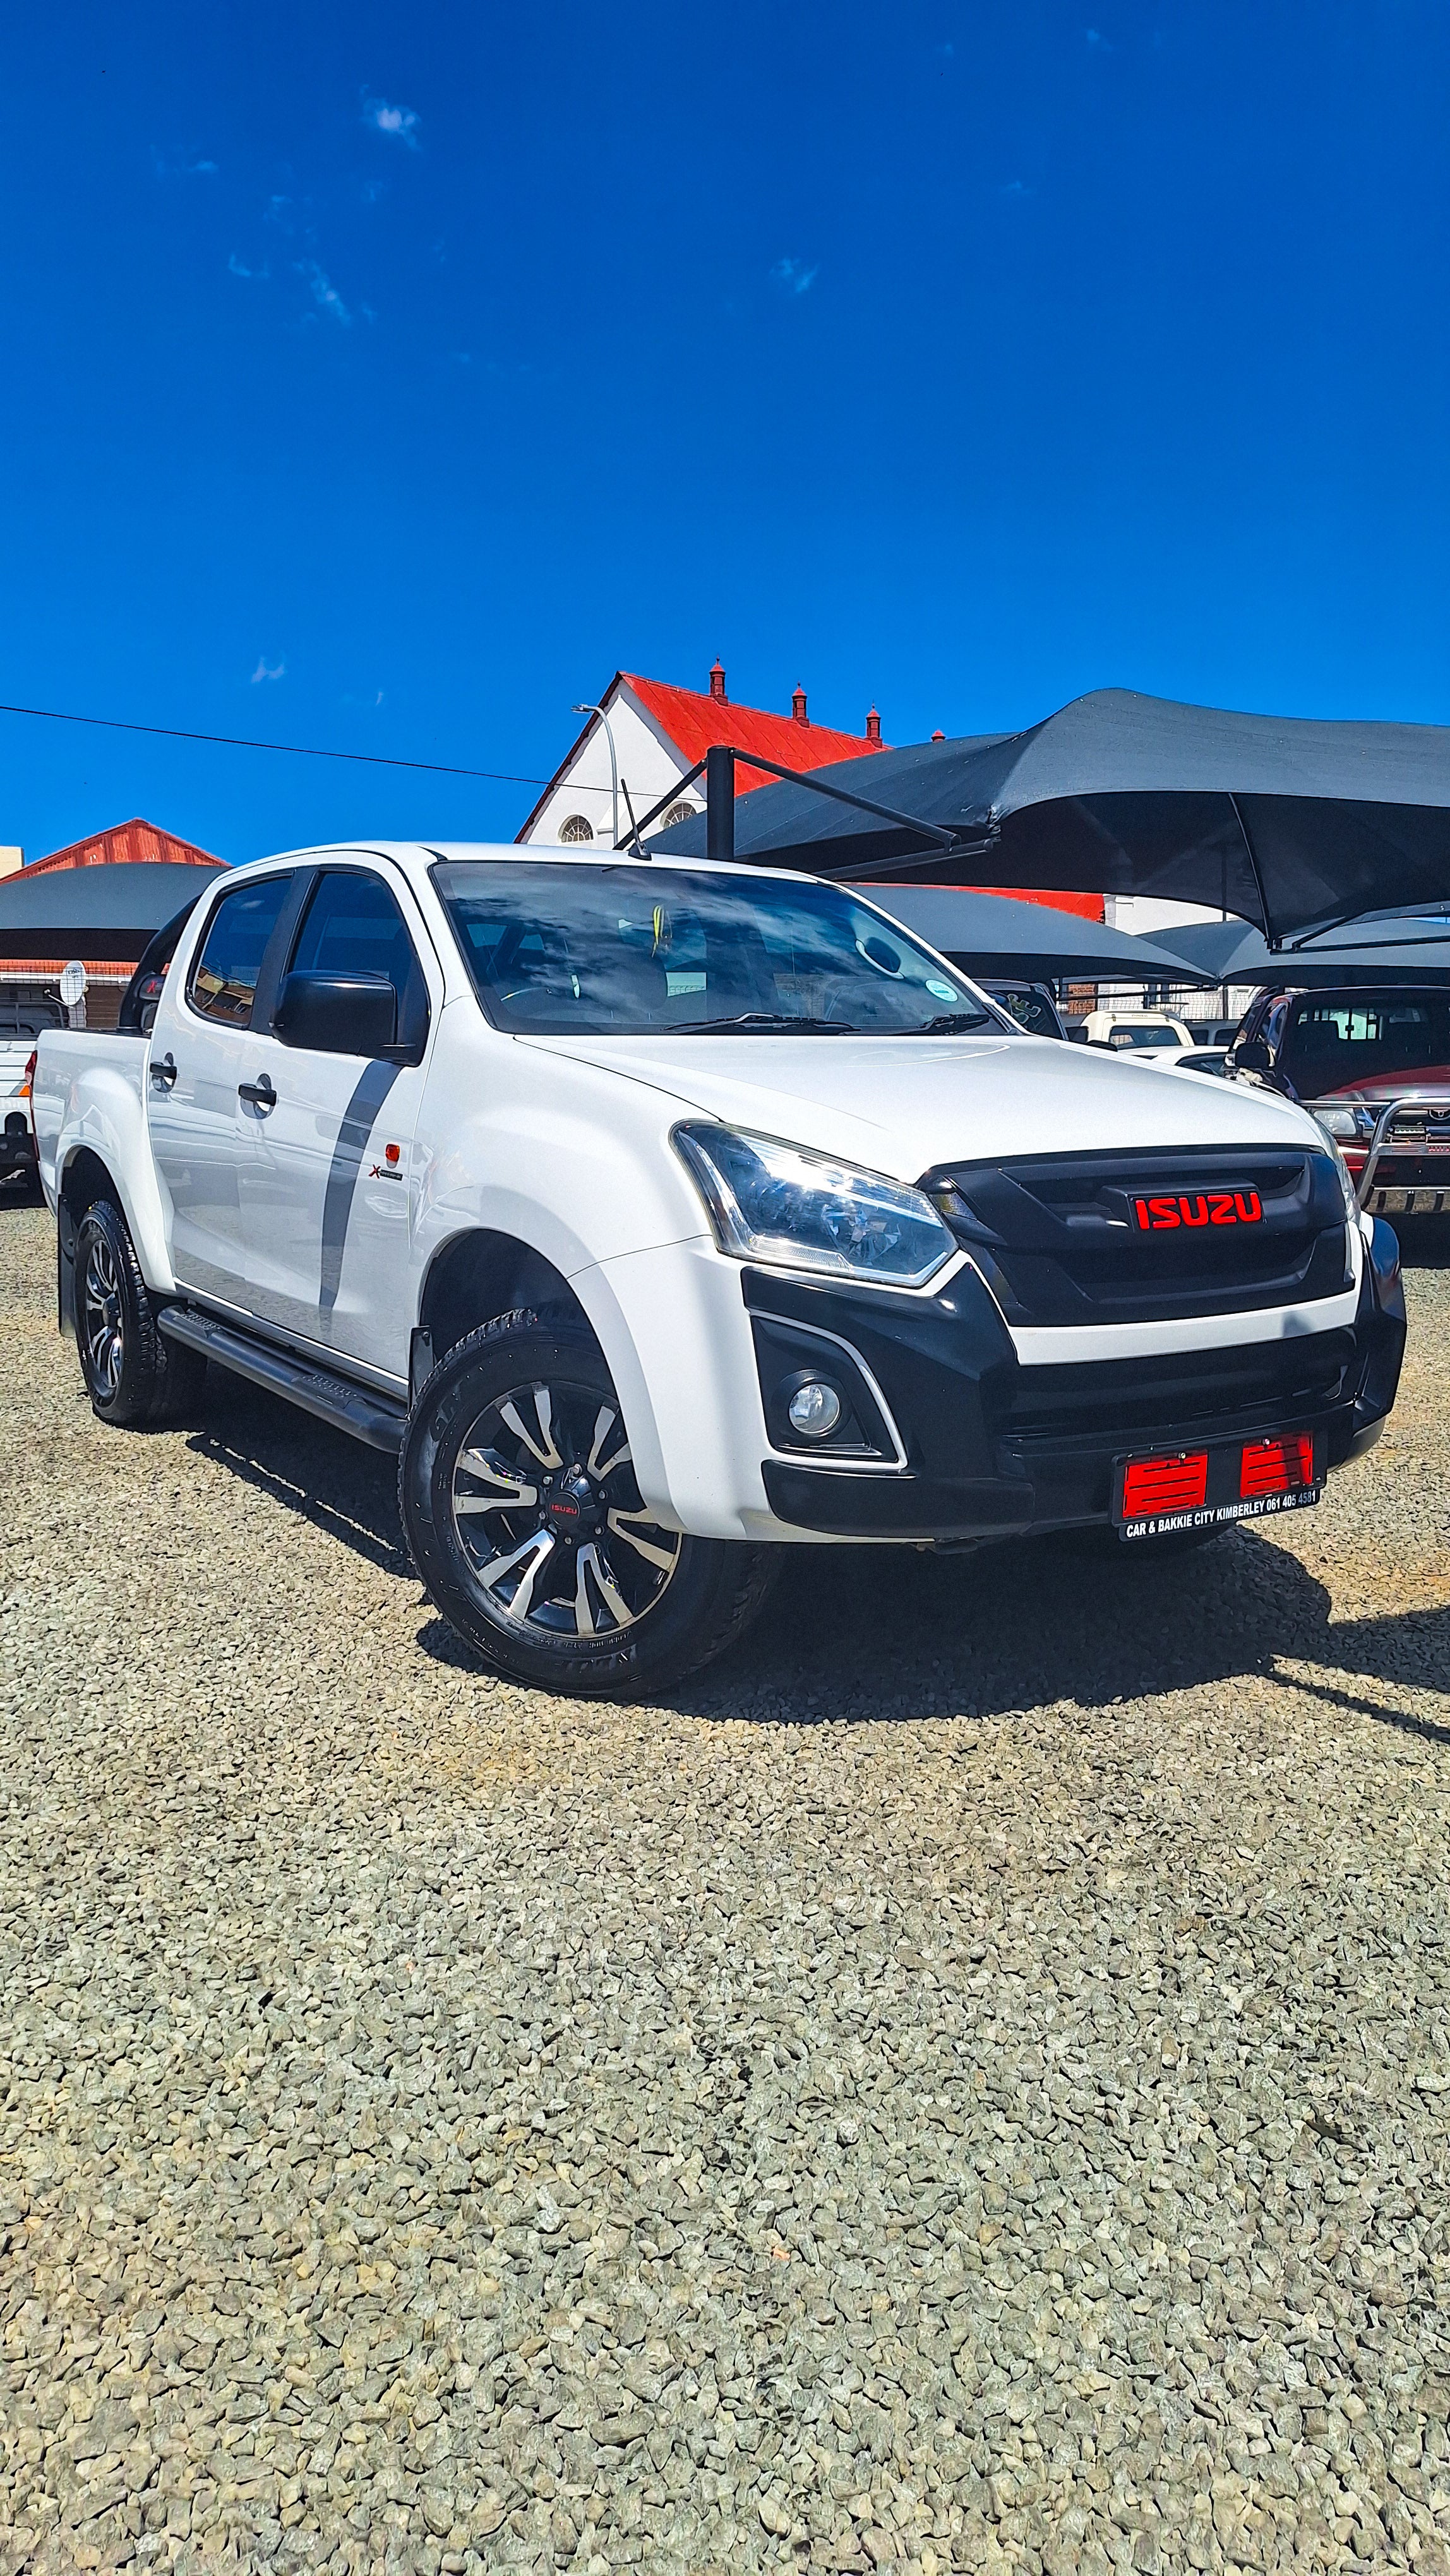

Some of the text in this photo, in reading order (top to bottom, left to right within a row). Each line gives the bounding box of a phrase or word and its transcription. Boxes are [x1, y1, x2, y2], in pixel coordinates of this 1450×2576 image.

[1135, 1192, 1262, 1229] ISUZU
[551, 1504, 577, 1515] ISUZU
[1127, 1489, 1315, 1537] CAR & BAKKIE CITY KIMBERLEY 061 405 4581
